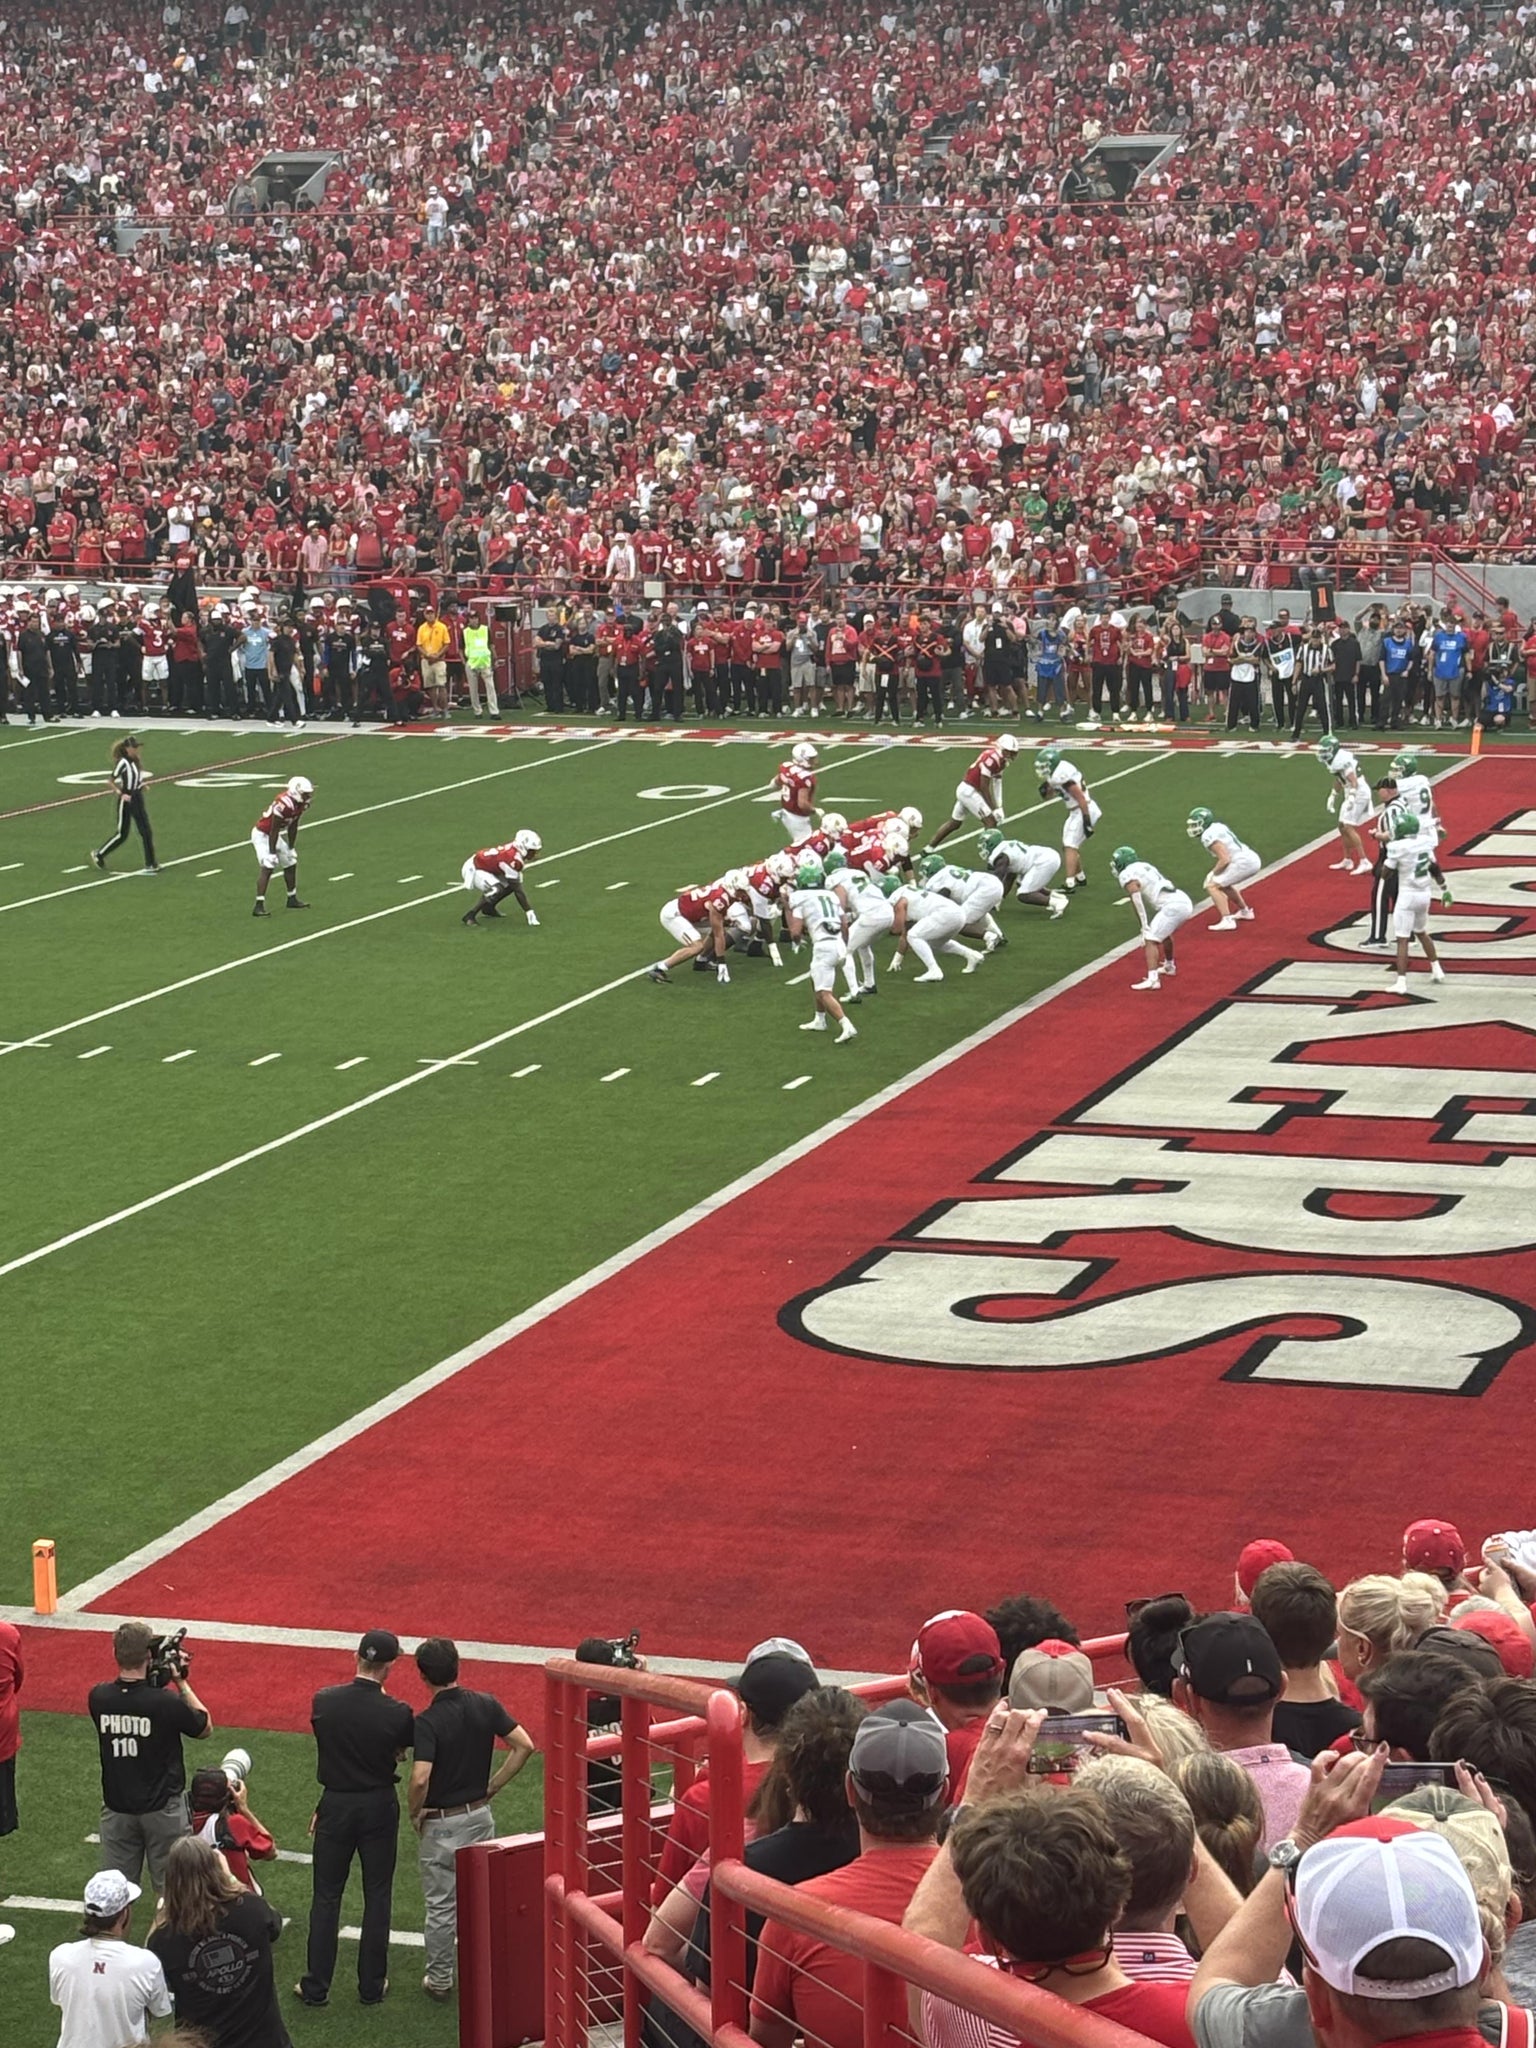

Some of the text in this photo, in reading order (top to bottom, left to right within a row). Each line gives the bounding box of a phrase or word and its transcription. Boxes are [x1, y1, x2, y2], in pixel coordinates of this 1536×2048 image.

[153, 630, 163, 647] 3
[1415, 852, 1429, 878] 2
[100, 1713, 151, 1738] PHOTO
[111, 1737, 138, 1758] 110
[93, 1961, 105, 1974] N
